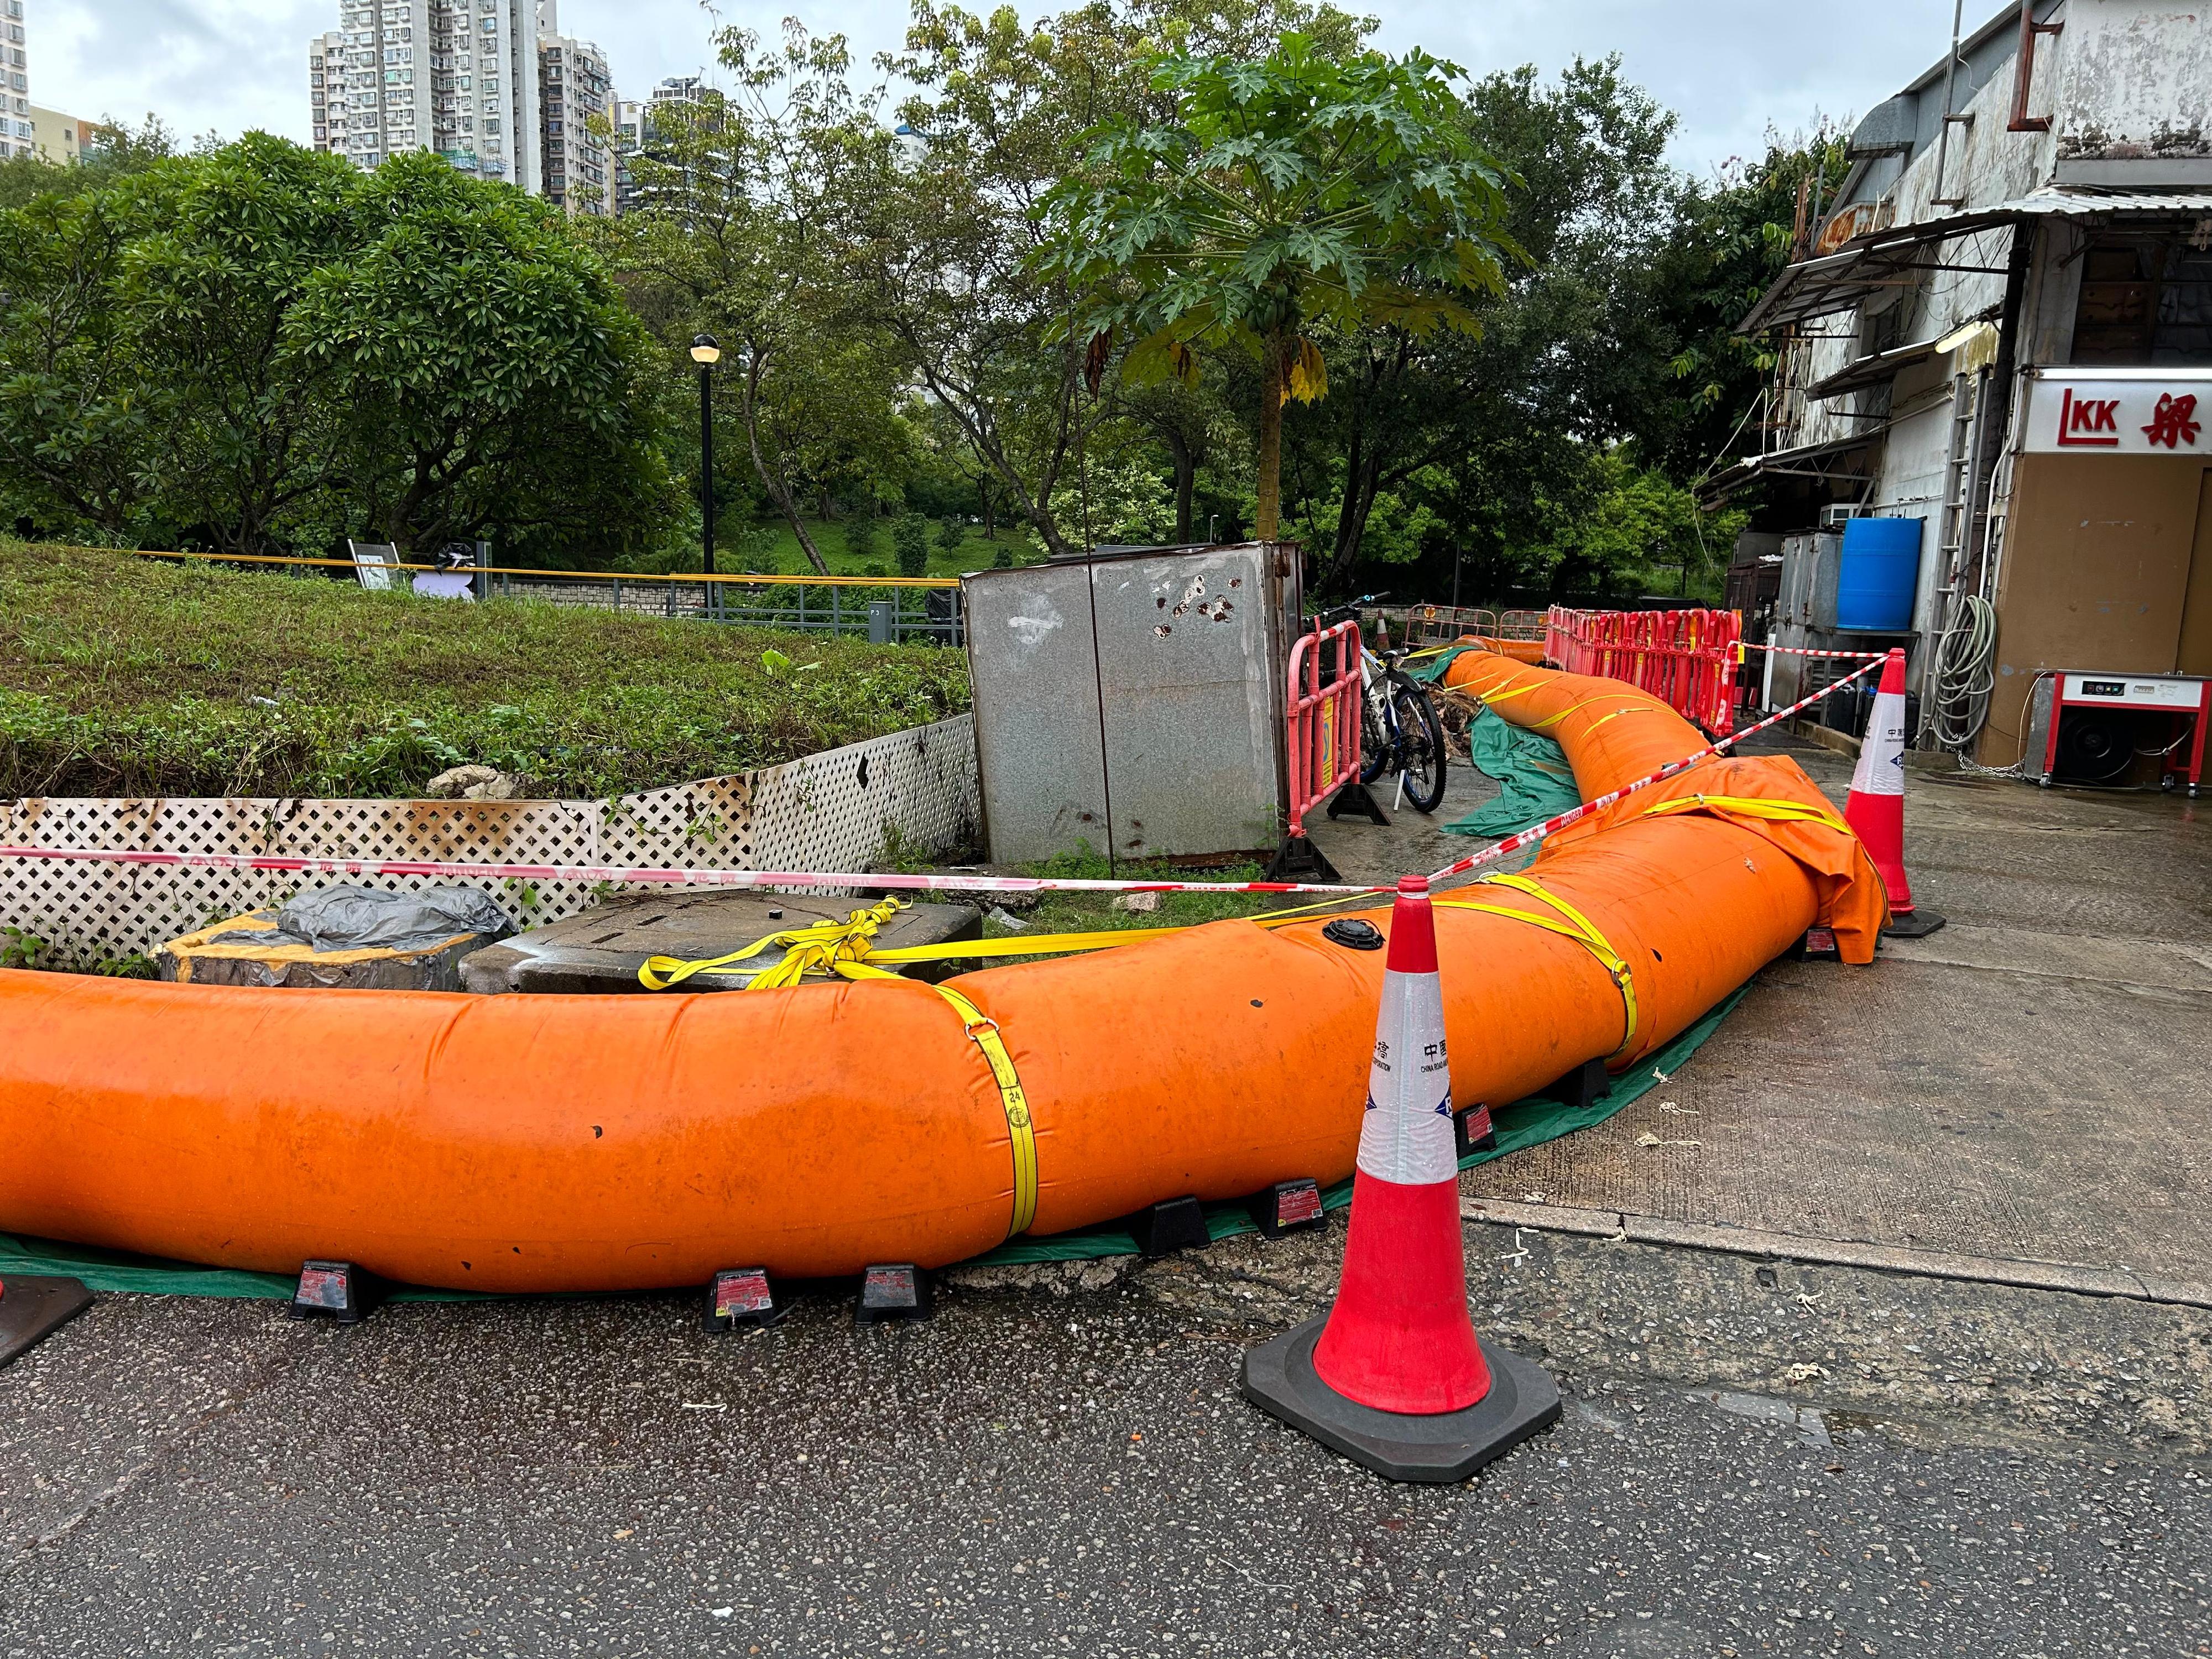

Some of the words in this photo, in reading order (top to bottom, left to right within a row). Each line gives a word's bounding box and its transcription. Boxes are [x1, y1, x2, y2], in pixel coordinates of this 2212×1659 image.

[2057, 388, 2120, 446] LKK
[1561, 810, 1581, 827] DANGER
[1421, 1064, 1434, 1073] CHINA
[1009, 1091, 1021, 1103] 24
